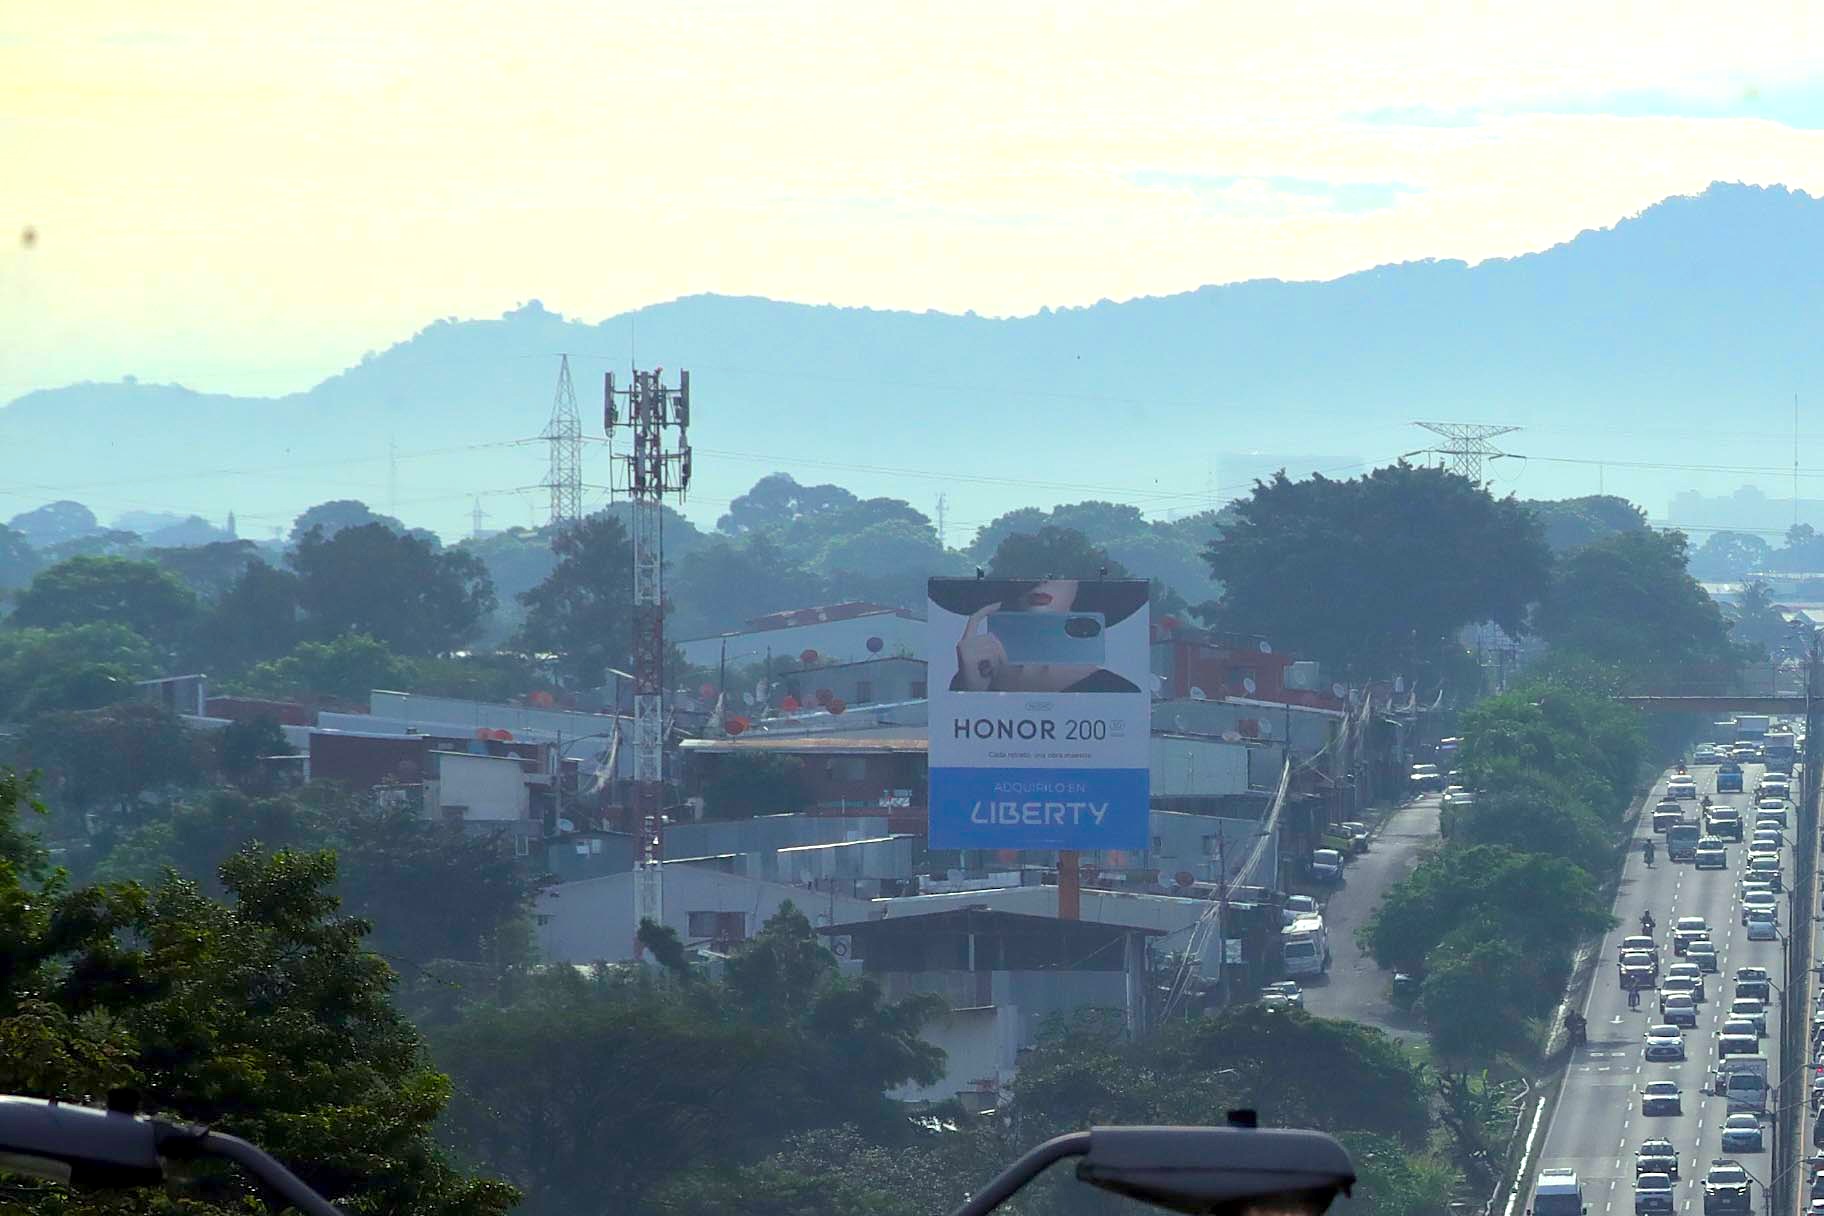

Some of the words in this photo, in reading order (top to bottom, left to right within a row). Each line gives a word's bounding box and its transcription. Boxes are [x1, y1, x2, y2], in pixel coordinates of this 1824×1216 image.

[954, 718, 1056, 740] HONOR
[1065, 719, 1106, 741] 200
[1068, 783, 1086, 793] EN
[970, 800, 1110, 825] LIBERTY
